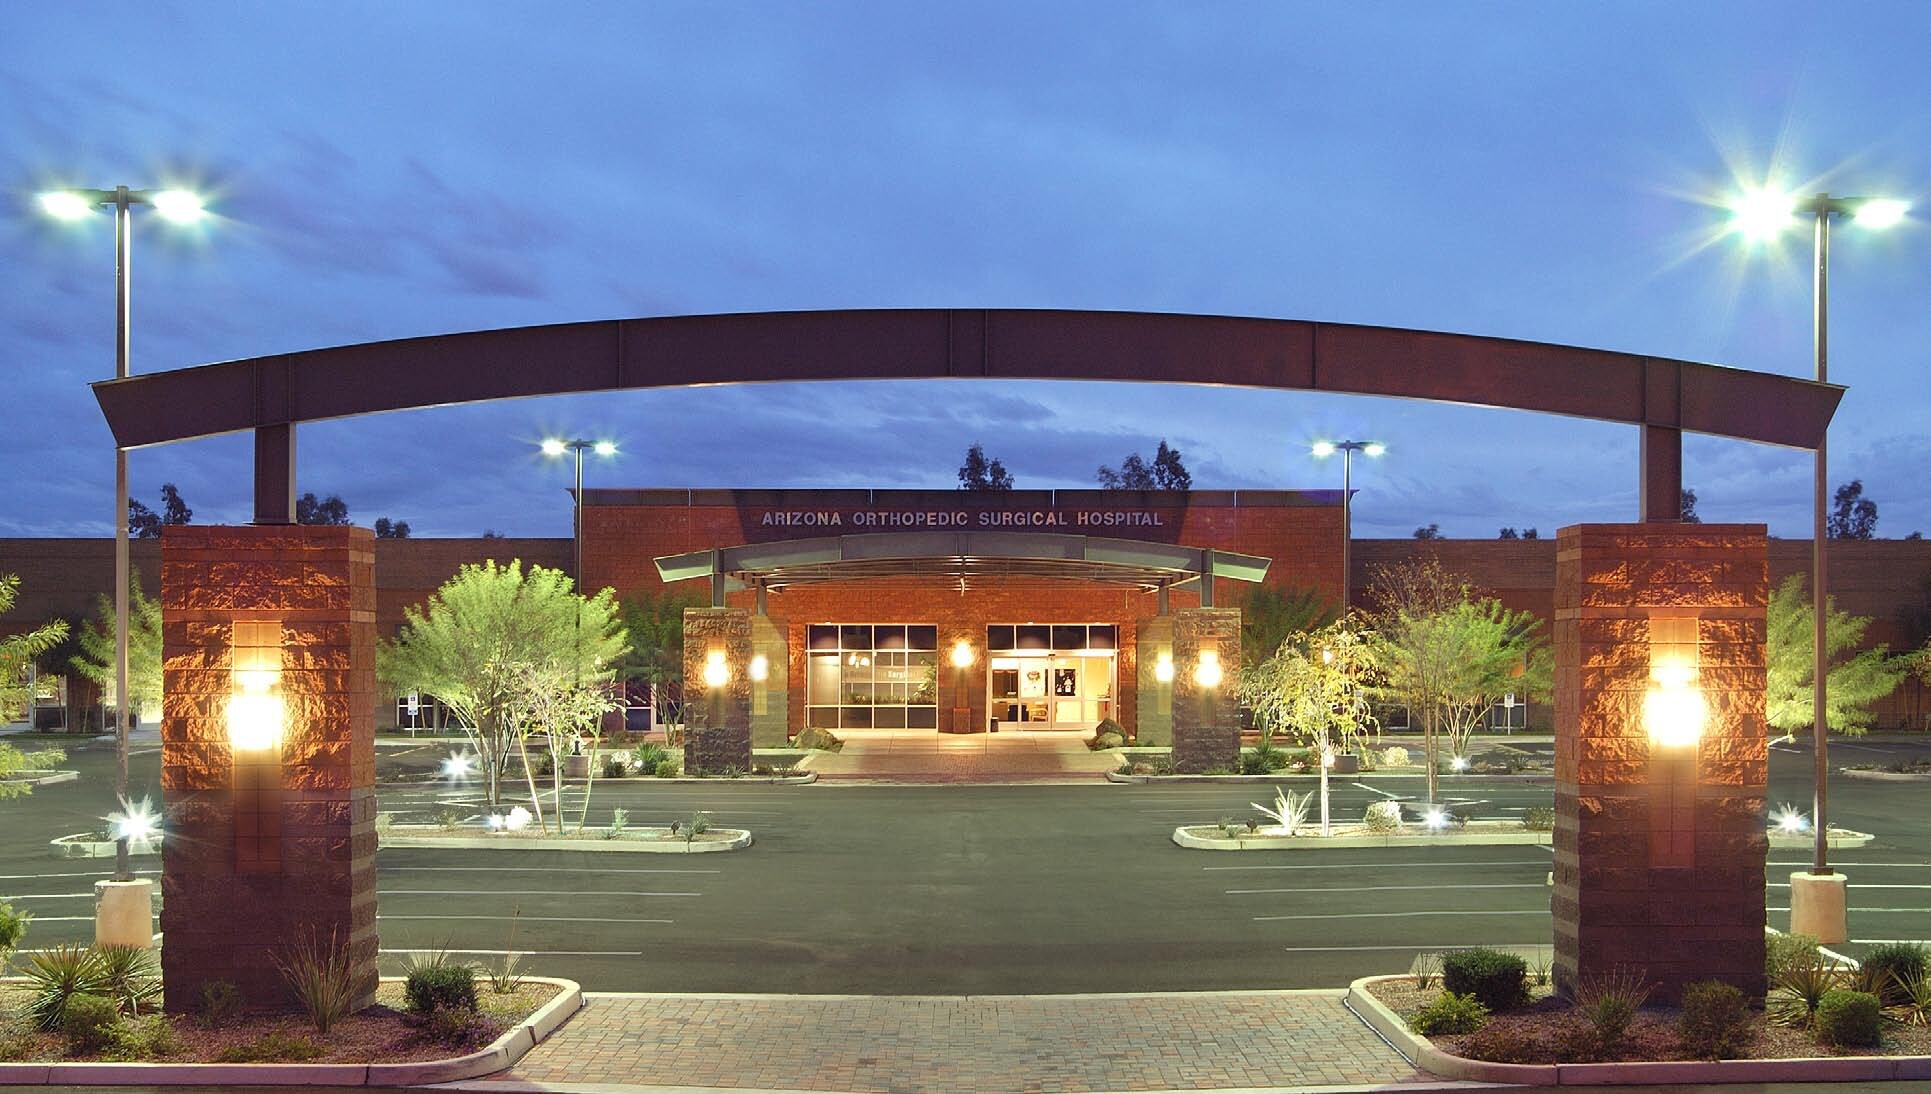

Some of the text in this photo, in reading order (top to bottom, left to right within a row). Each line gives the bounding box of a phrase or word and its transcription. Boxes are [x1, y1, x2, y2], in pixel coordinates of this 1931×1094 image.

[762, 512, 1163, 525] ARIZONA ORTHOPEDIC SURGICAL HOSPITAL
